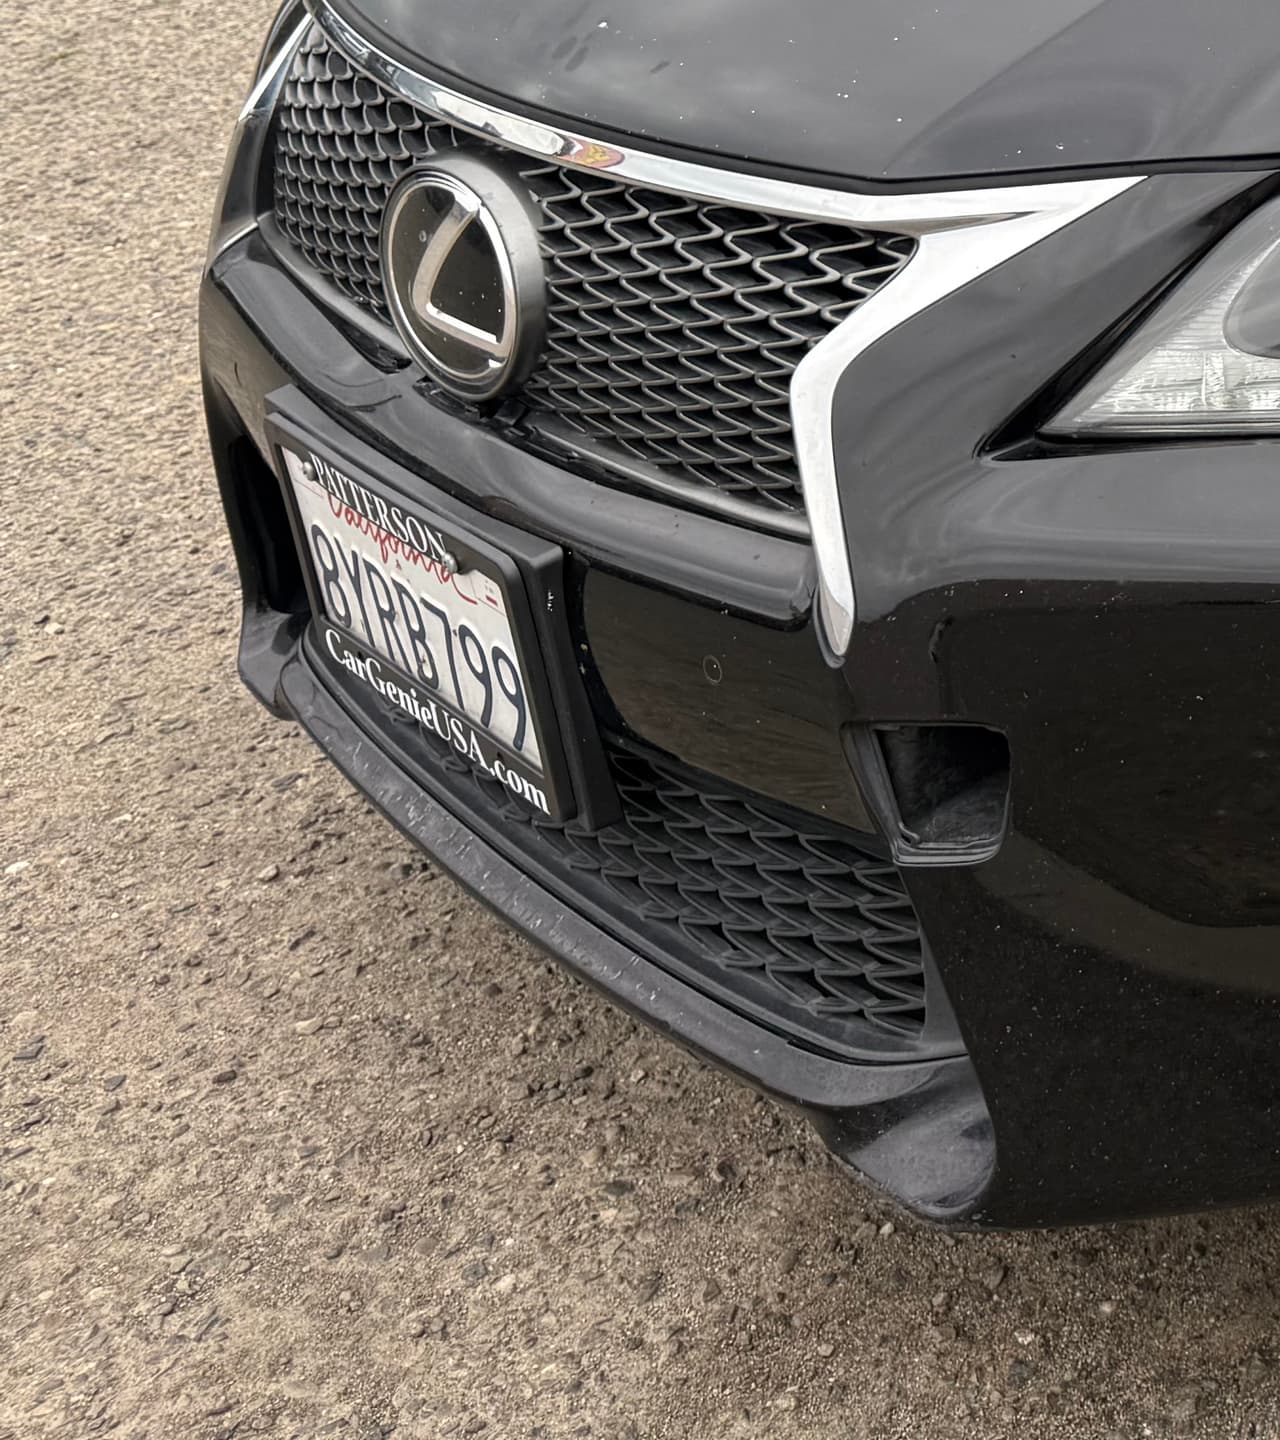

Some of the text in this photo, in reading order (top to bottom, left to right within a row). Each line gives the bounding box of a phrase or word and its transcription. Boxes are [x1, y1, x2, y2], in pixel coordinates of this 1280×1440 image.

[308, 450, 447, 560] PATTERSON
[311, 523, 527, 752] 8YRB799
[325, 628, 551, 816] CarGenieUSA.com
